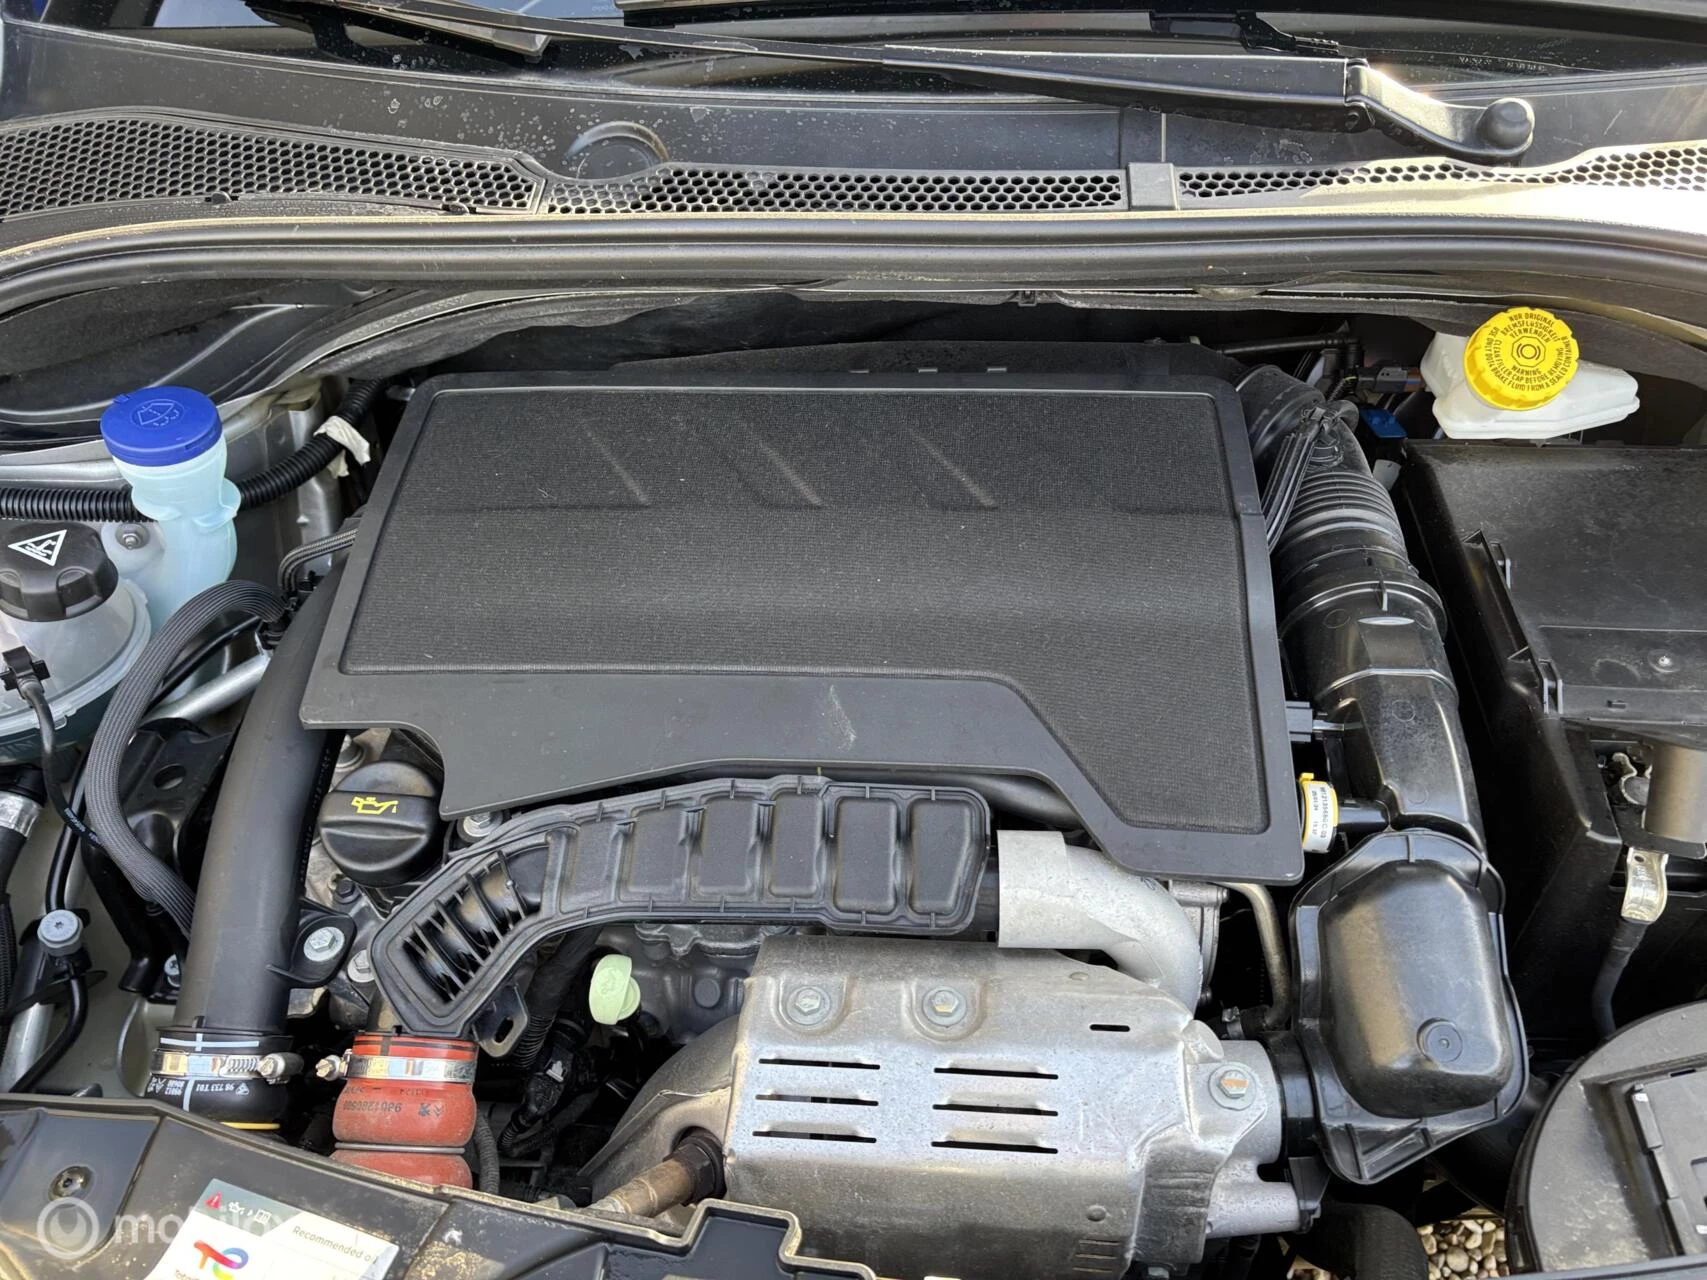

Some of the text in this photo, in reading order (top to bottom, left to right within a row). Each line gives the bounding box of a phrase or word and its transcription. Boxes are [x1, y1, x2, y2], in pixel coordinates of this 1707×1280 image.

[1508, 312, 1554, 327] NUR ORIGINAL
[1509, 327, 1552, 343] VERWENDEN
[1491, 367, 1509, 384] BRAKE
[1507, 381, 1526, 391] FLUID
[1495, 359, 1513, 378] FILLER
[1511, 374, 1524, 383] CAP
[1525, 373, 1550, 384] BEFORE
[1511, 365, 1542, 376] WARNING
[292, 1226, 364, 1259] Recommended
